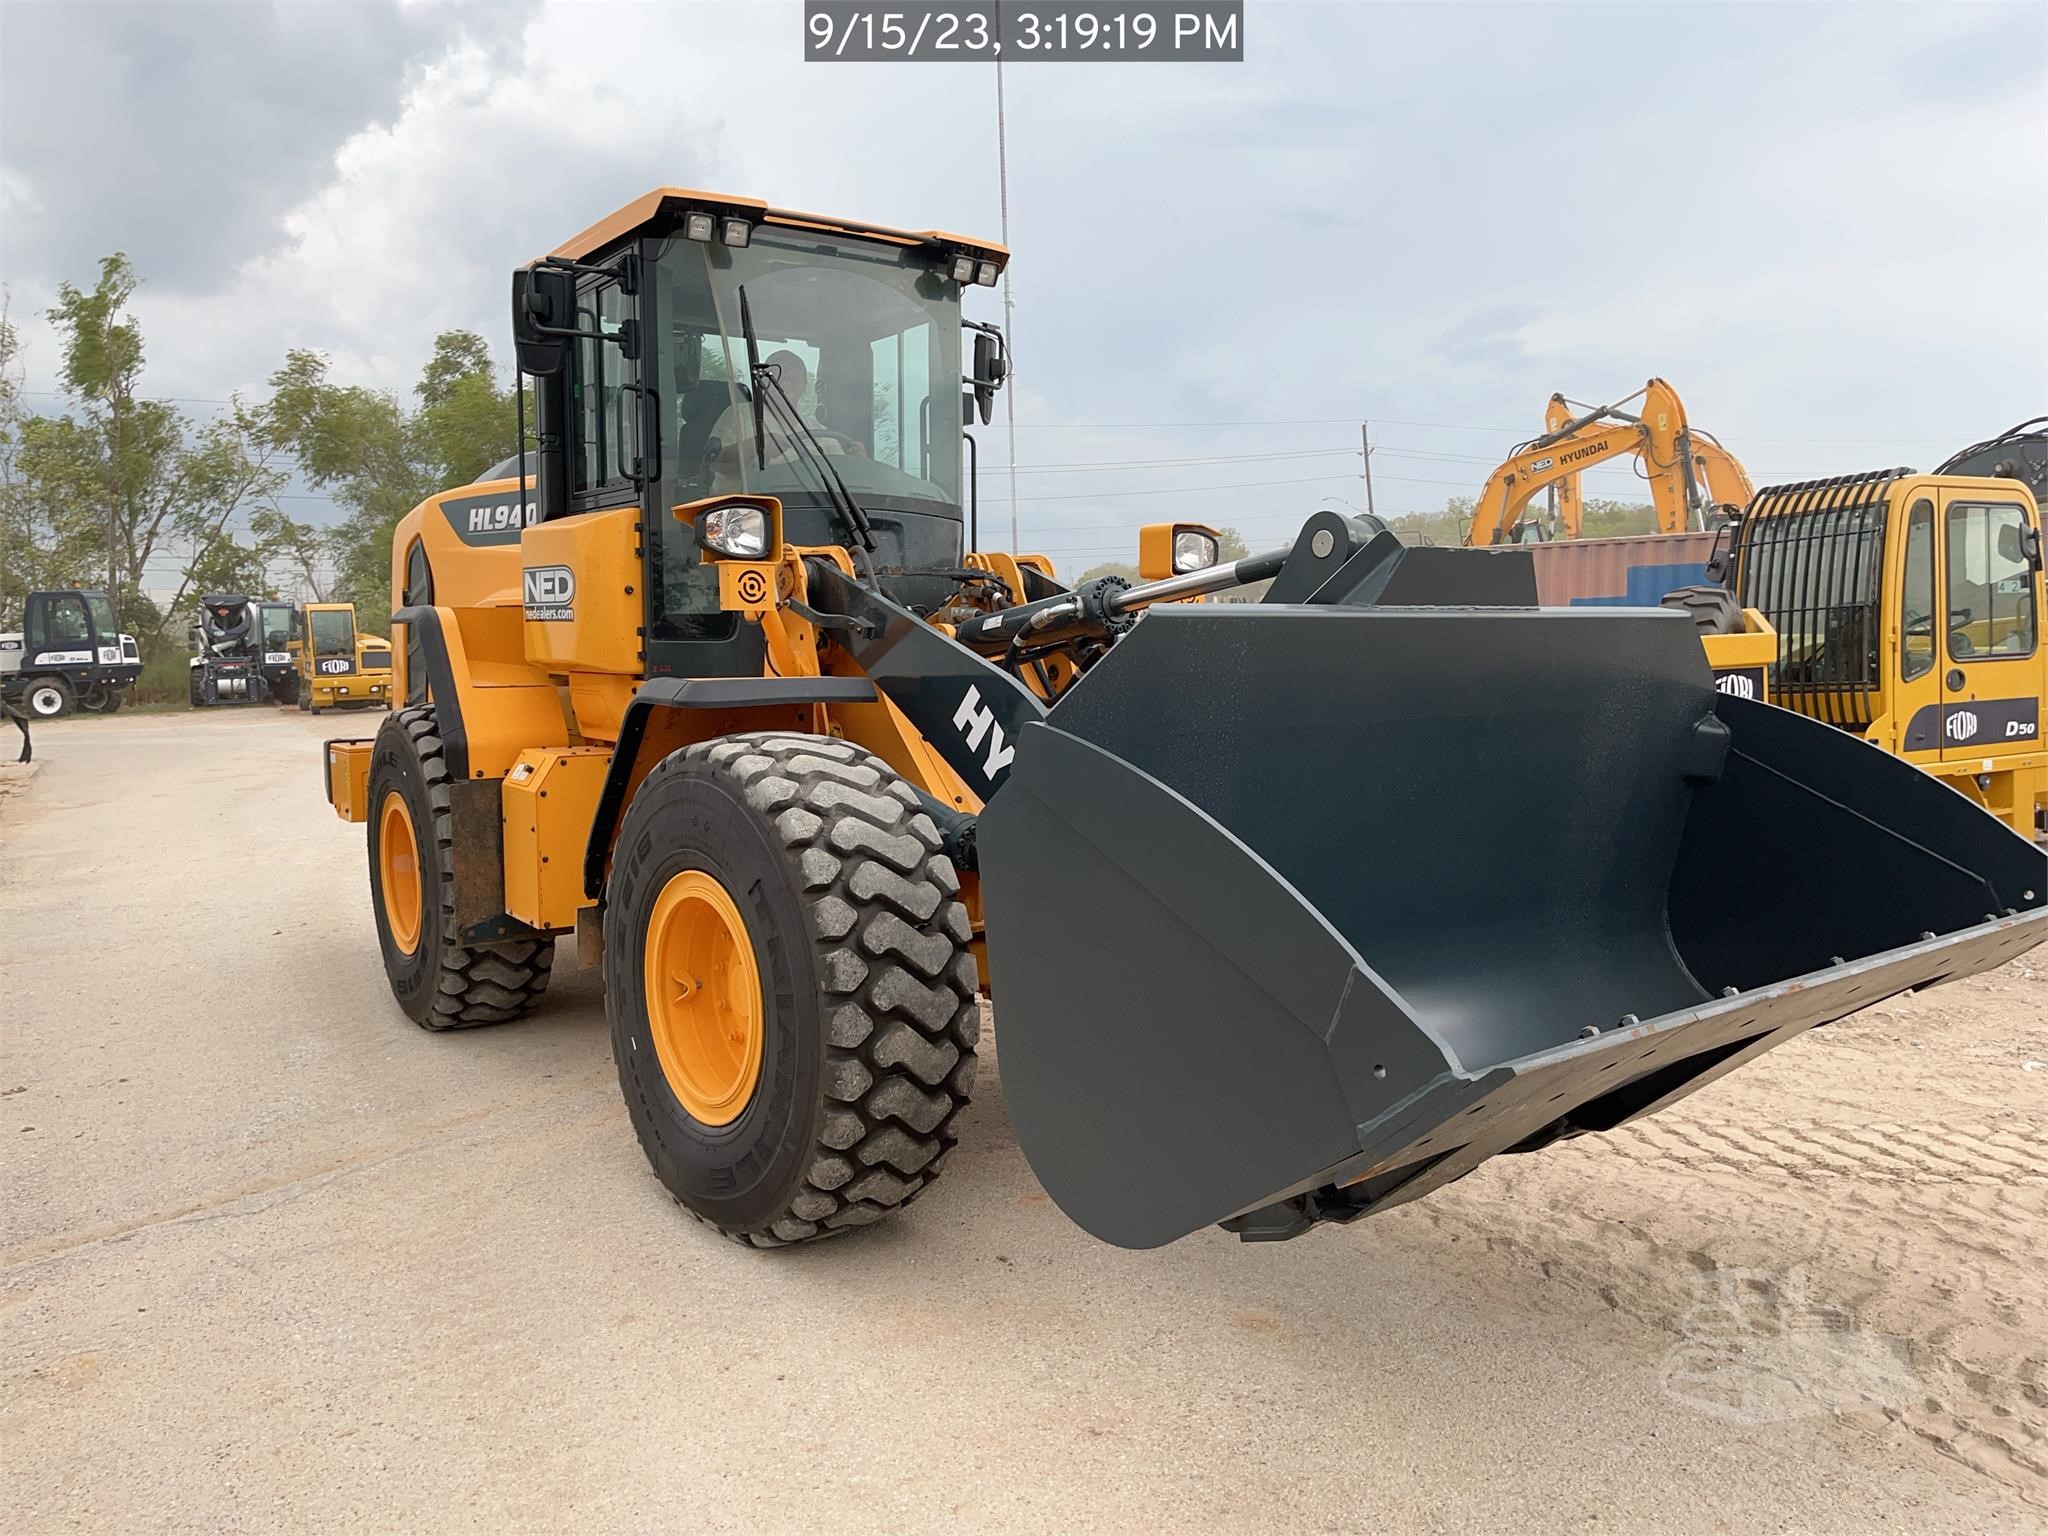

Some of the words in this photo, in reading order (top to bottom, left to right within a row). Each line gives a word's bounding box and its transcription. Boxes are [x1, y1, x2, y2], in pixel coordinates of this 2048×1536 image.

[1531, 458, 1552, 472] NED
[1559, 439, 1609, 466] HYUNDAI
[468, 502, 537, 532] HL940
[524, 570, 574, 603] NED
[525, 606, 574, 620] nedealers.com
[953, 684, 1015, 781] HY
[2005, 721, 2035, 737] D50
